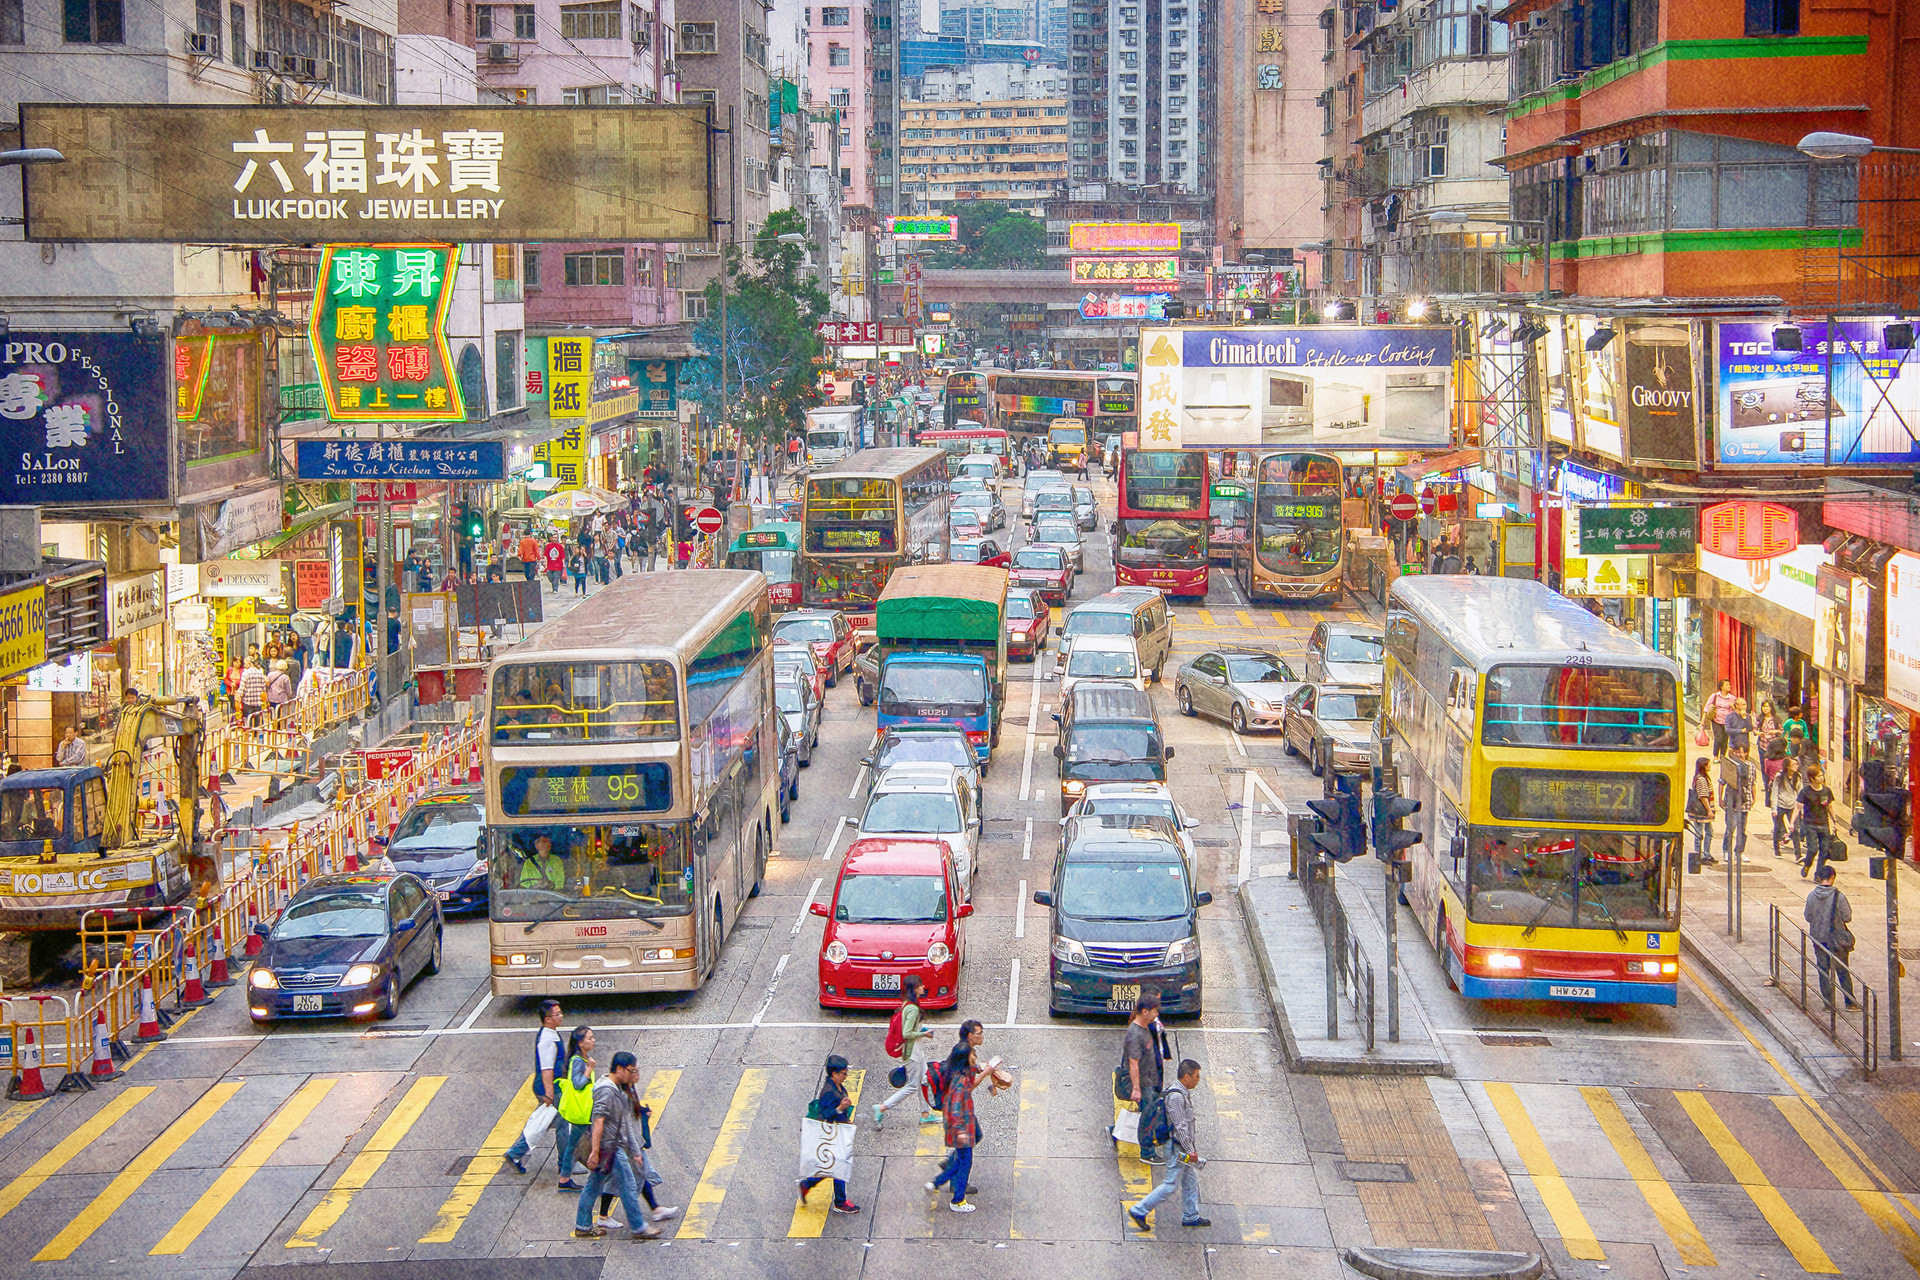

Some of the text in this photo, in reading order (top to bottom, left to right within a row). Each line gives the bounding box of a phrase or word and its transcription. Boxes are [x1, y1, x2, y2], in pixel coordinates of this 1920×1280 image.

[232, 127, 505, 194] 六福珠寶
[233, 198, 506, 220] LUKFOOK JEWELLERY
[333, 250, 440, 298] 東昇
[335, 305, 430, 342] 廚櫃
[1379, 343, 1435, 367] Cooking
[1729, 342, 1771, 356] TGC
[340, 386, 446, 409] 請上一樓
[1631, 385, 1691, 408] GROOVY
[323, 442, 405, 462] 新德廚櫃
[322, 462, 479, 478] Sun Tak Kitchen Design
[16, 472, 88, 485] Tel: 2380 8807
[1306, 505, 1323, 517] 905
[1584, 528, 1692, 541] 工聯會工人醫療所
[1711, 504, 1790, 556] PLC
[26, 596, 44, 634] 168
[1565, 655, 1593, 665] 2249
[367, 750, 411, 760] PEDESTRIANS
[547, 777, 591, 795] 翠林
[607, 774, 639, 800] 95
[550, 794, 589, 803] TSUI LAM
[1596, 783, 1634, 809] E21
[584, 926, 607, 936] KMB
[572, 980, 613, 989] JU 5403
[874, 981, 899, 990] 8073
[1120, 985, 1132, 993] KK
[301, 995, 314, 1003] NC
[1117, 992, 1136, 1000] 1162
[1555, 987, 1590, 997] HW 674
[297, 1002, 319, 1011] 2016
